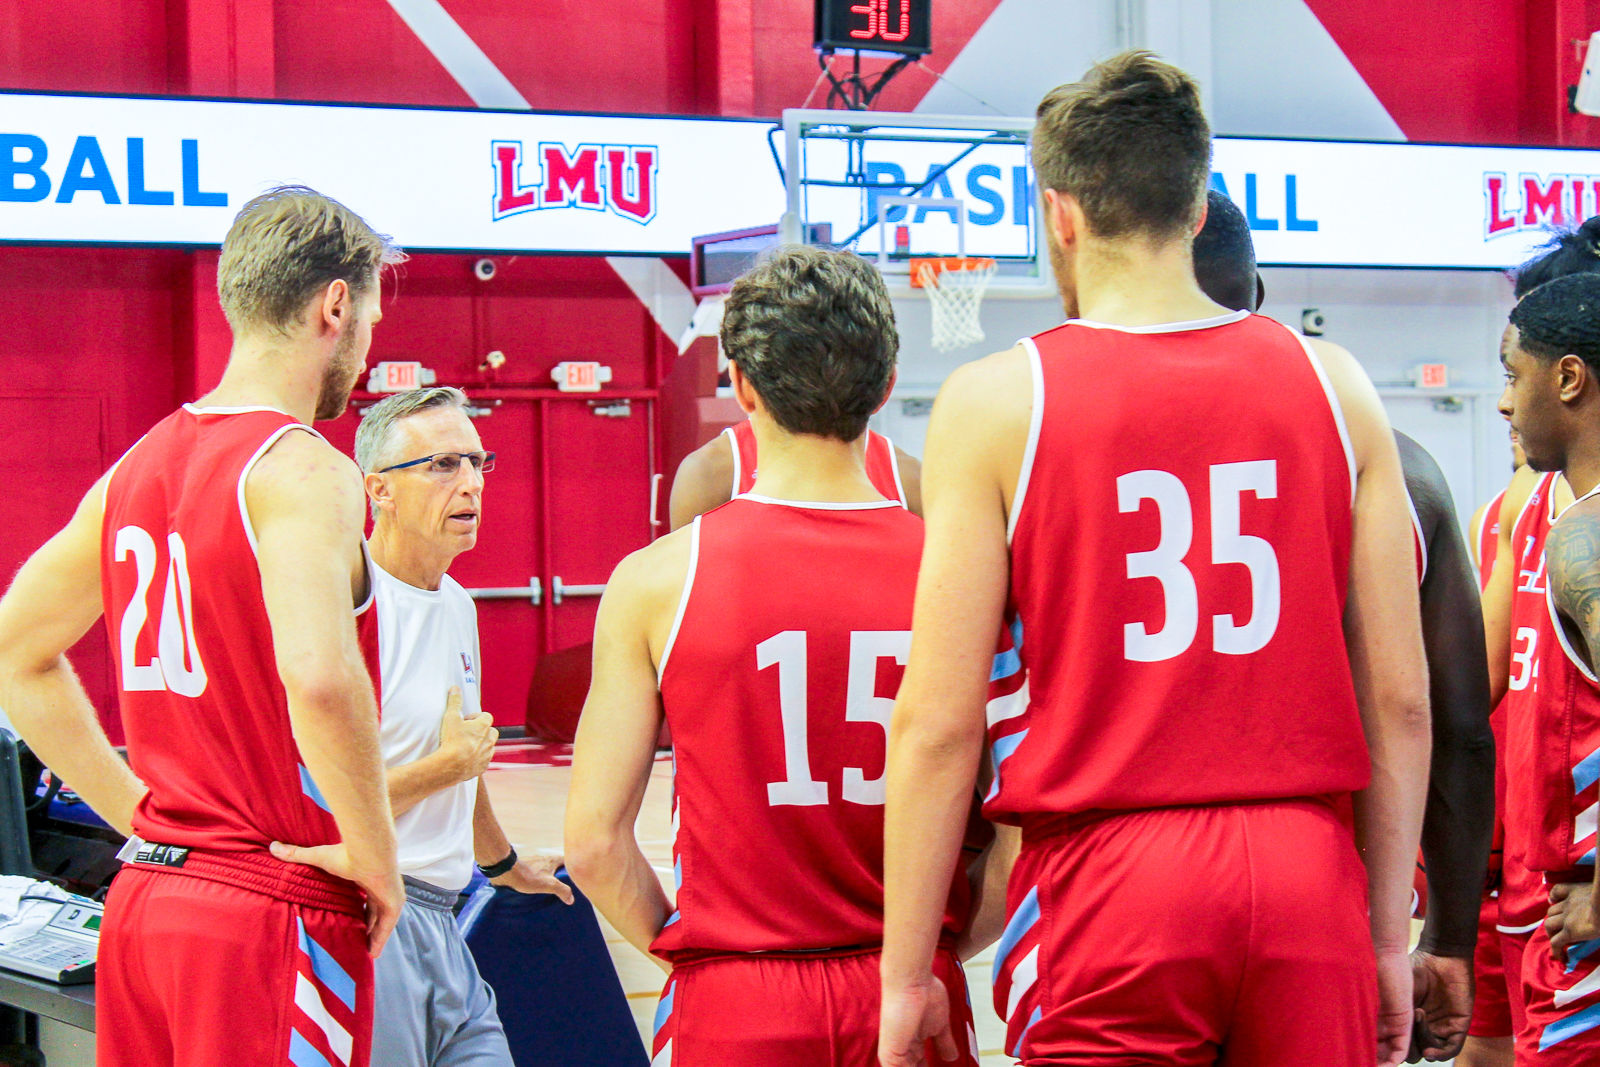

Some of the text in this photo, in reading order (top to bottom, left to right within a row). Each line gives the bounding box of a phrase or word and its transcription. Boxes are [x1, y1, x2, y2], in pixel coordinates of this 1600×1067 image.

[849, 0, 911, 42] 30
[491, 139, 659, 226] LMU
[387, 363, 417, 388] EXIT
[567, 363, 596, 388] EXIT
[1116, 459, 1281, 662] 35
[114, 525, 209, 698] 20
[1509, 626, 1540, 693] 3
[755, 630, 913, 806] 15
